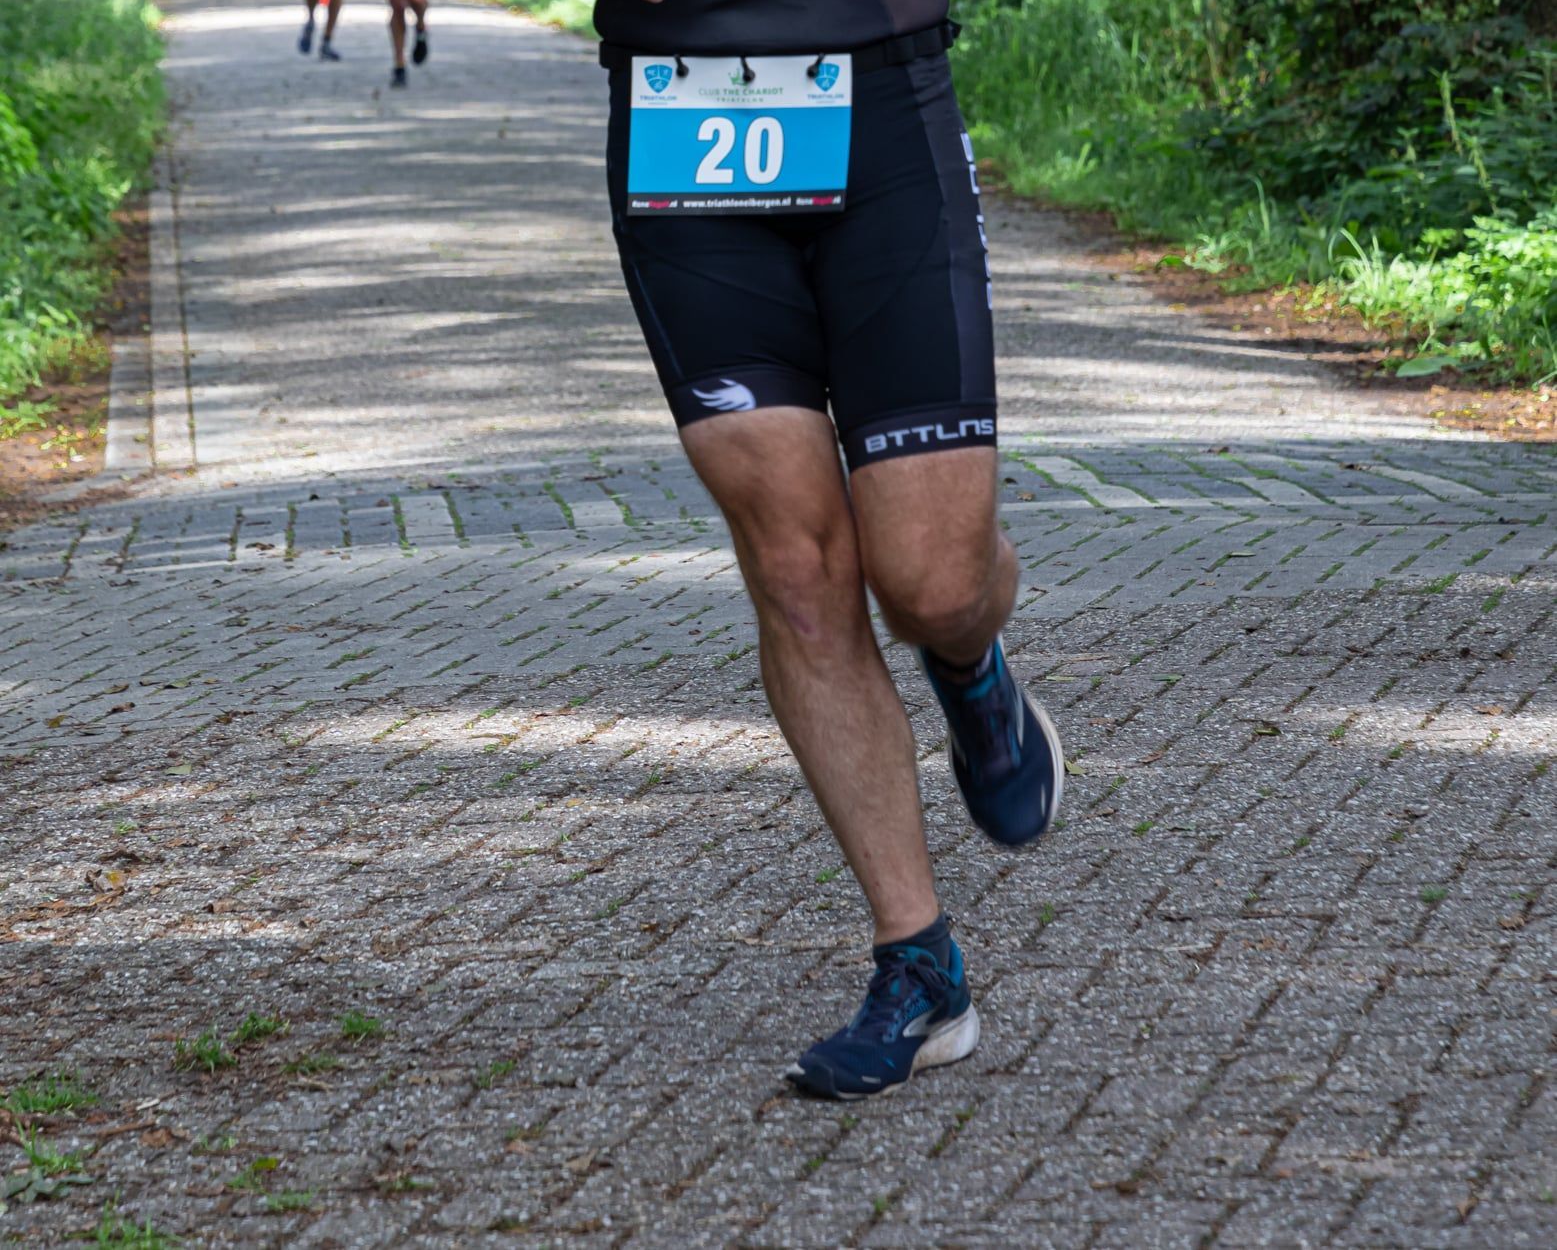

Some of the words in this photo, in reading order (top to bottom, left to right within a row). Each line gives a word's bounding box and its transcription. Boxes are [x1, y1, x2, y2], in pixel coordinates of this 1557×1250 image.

[698, 87, 720, 96] CLUB
[723, 87, 740, 96] THE
[742, 86, 783, 96] CHARIOT
[695, 116, 784, 184] 20
